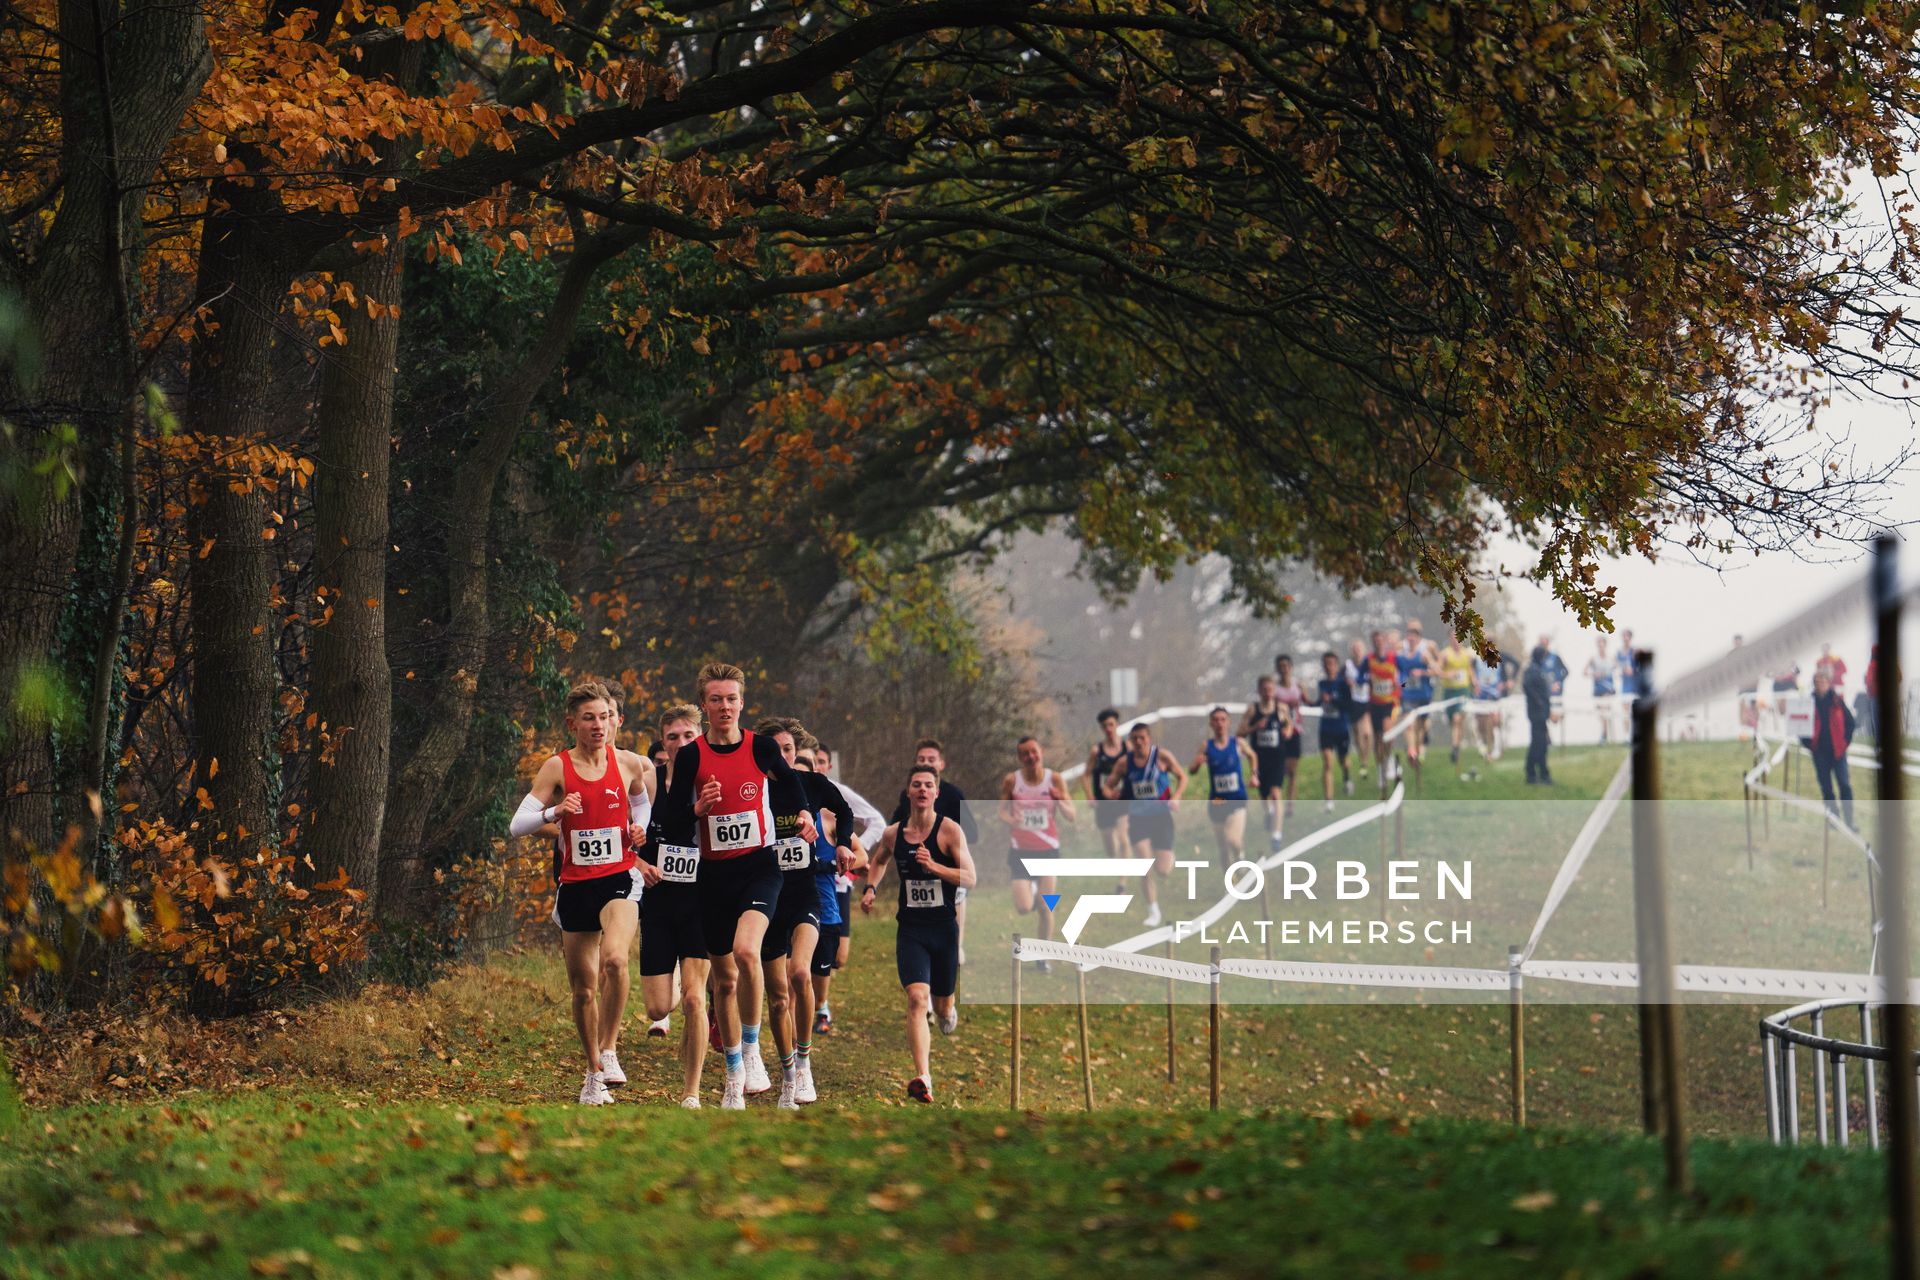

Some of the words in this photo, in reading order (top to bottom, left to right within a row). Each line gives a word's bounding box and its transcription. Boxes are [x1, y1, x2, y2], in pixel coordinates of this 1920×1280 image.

[776, 815, 798, 826] SW
[717, 823, 751, 842] 607
[578, 839, 612, 857] 931
[663, 856, 696, 874] 800
[911, 888, 935, 901] 801
